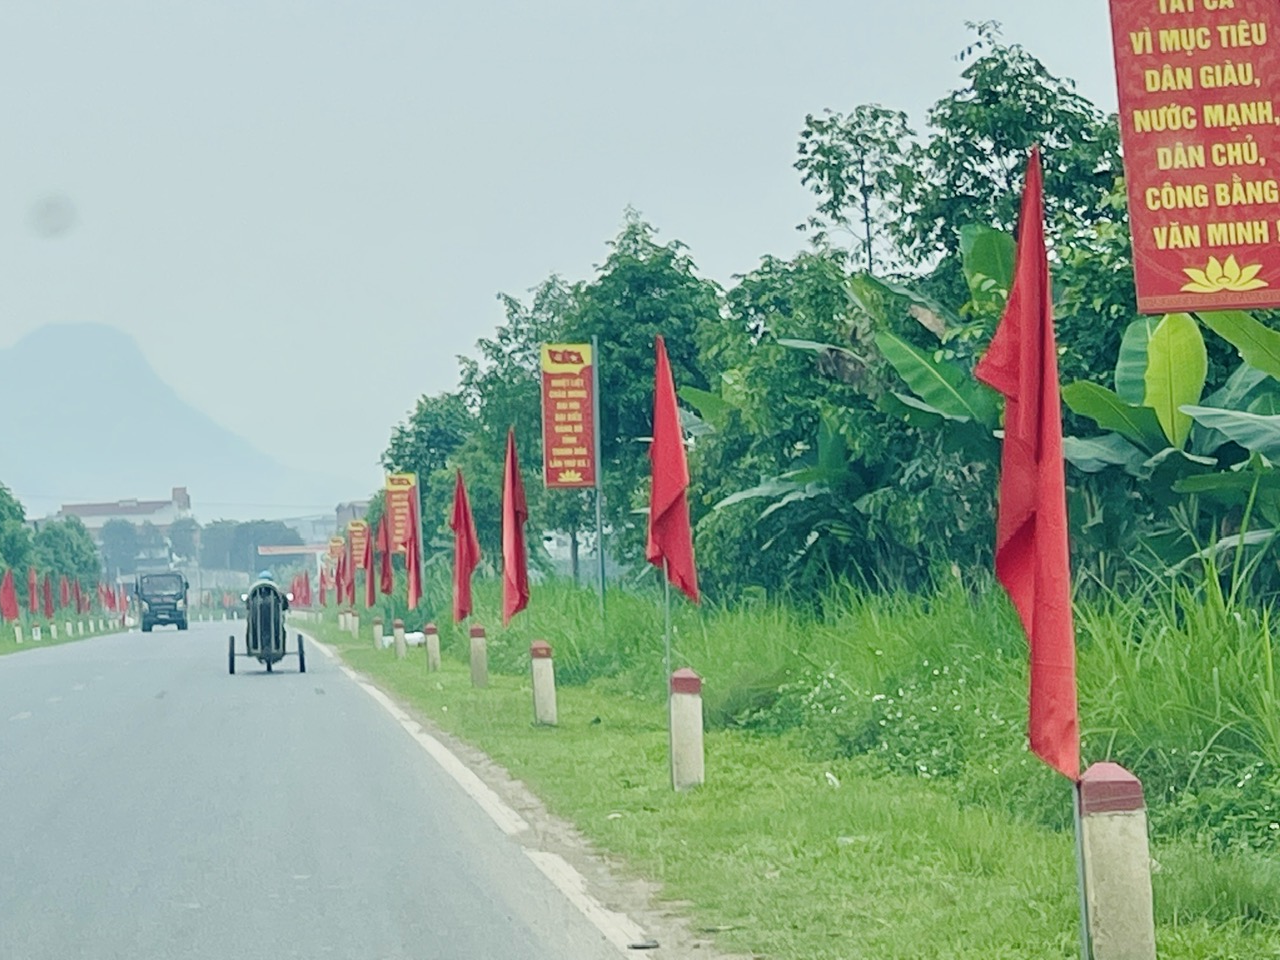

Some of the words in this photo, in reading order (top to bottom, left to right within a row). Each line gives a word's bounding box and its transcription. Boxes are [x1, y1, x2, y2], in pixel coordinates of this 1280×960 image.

[1130, 27, 1153, 55] VÌ
[1159, 27, 1211, 56] MỤC
[1217, 20, 1267, 48] TIÊU
[1145, 64, 1193, 92] DÂN
[1200, 60, 1261, 89] GIÀU,
[1133, 103, 1197, 132] NƯỚC
[1204, 101, 1280, 132] MẠNH,
[1157, 142, 1205, 171] DÂN
[1212, 134, 1266, 167] CHỦ,
[1146, 182, 1209, 211] CÔNG
[1215, 173, 1279, 207] BẰNG
[1153, 222, 1200, 250] VĂN
[1207, 220, 1269, 247] MINH
